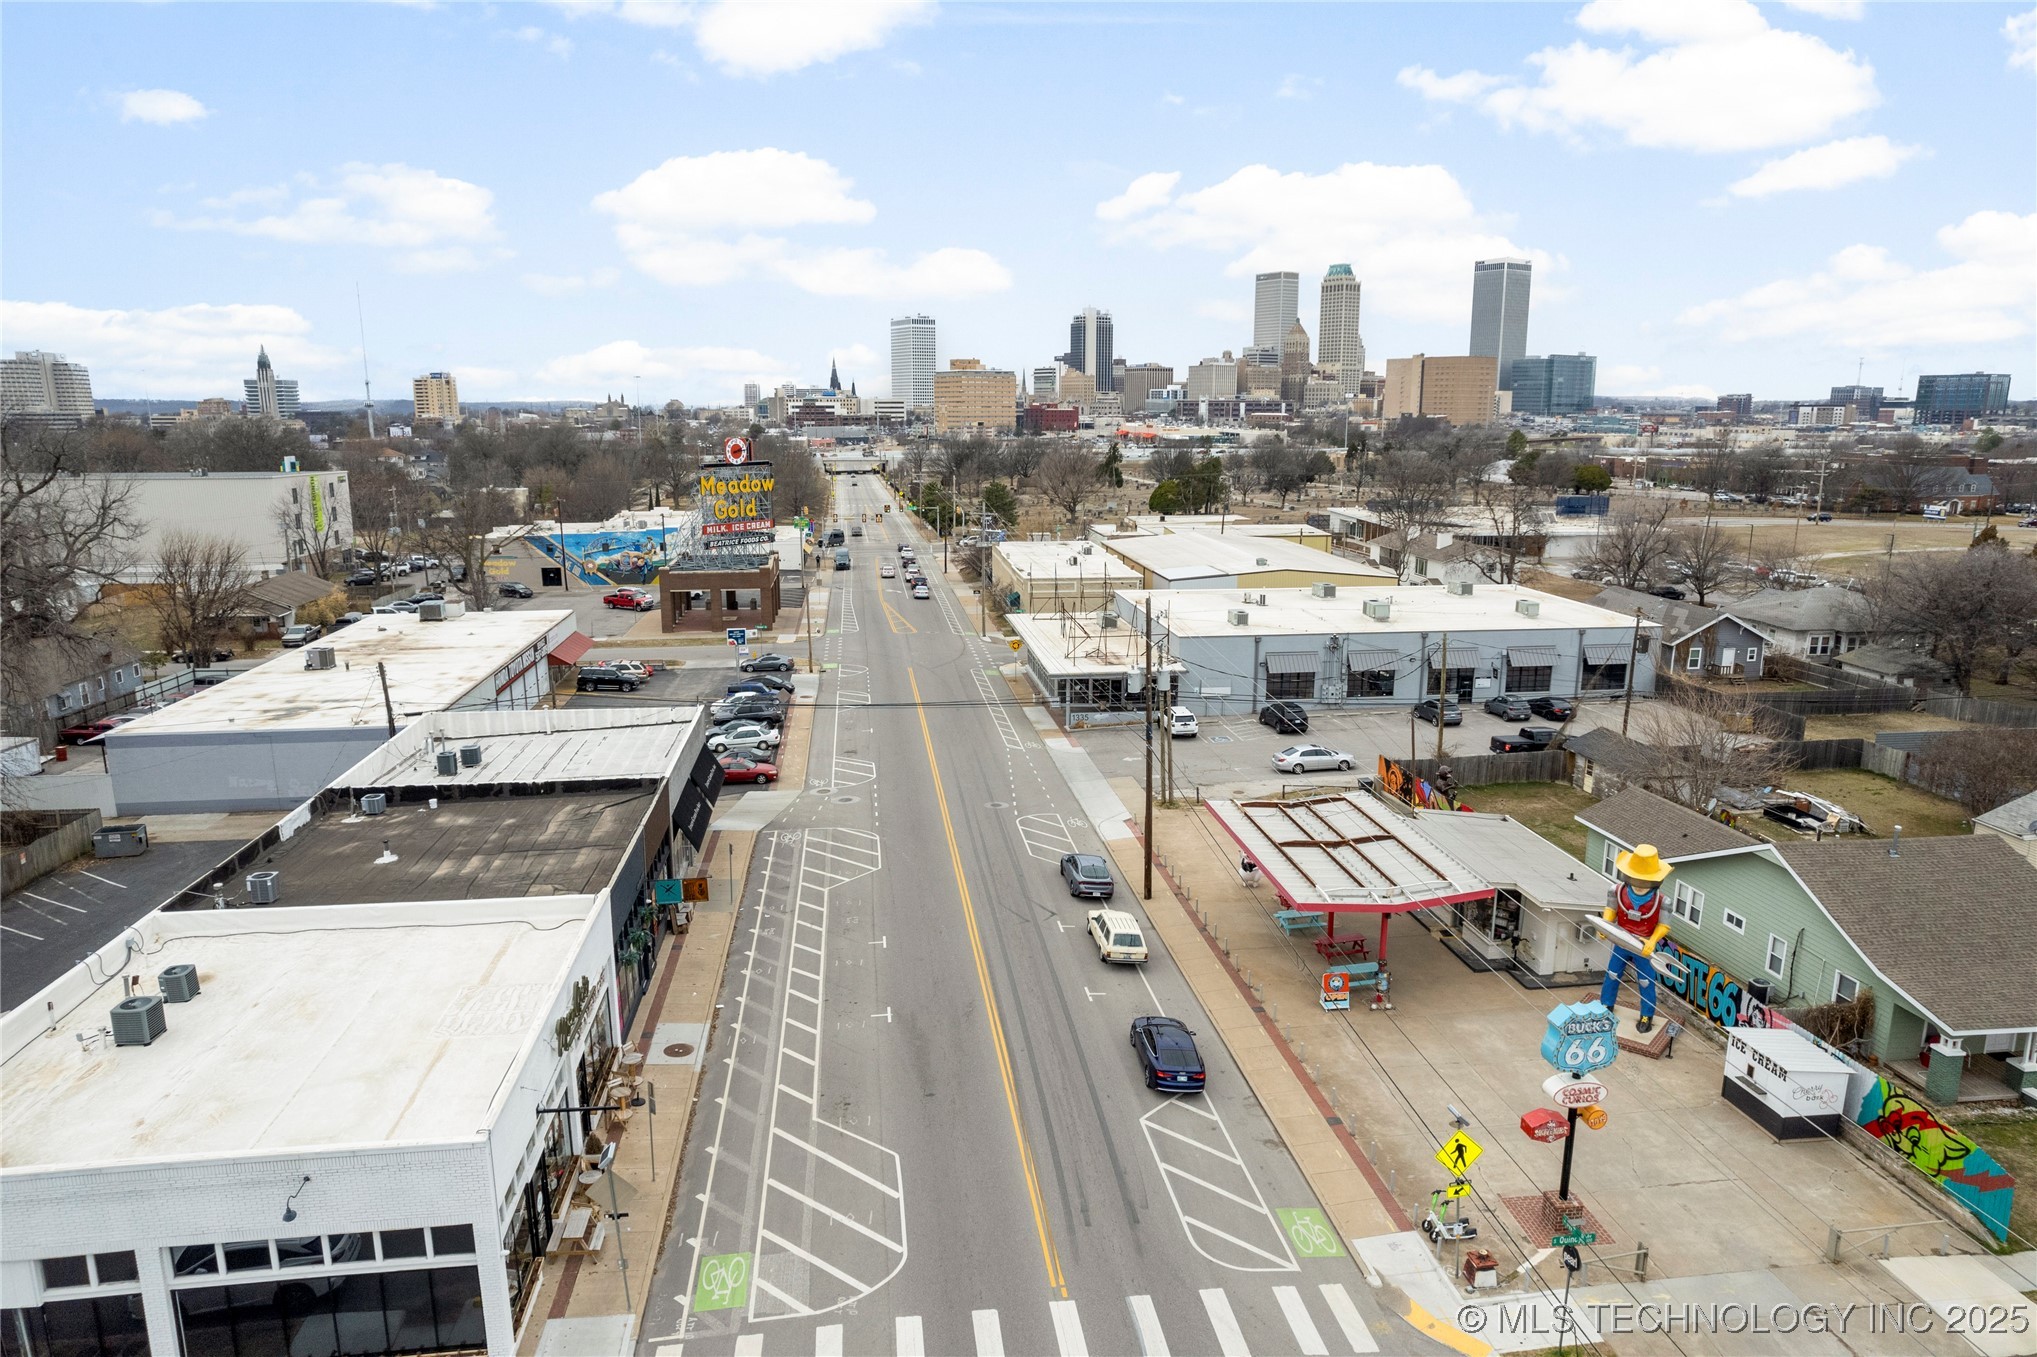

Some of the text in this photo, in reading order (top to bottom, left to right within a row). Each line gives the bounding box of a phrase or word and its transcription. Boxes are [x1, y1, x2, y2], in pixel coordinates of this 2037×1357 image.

[700, 474, 774, 496] Meadow
[714, 498, 757, 519] Gold
[732, 523, 745, 531] ICE
[746, 520, 771, 530] CREAM
[709, 539, 739, 547] BEATRICE
[1708, 972, 1739, 1027] 66
[1567, 1020, 1611, 1034] BUCK'S
[1565, 1036, 1606, 1066] 66
[1731, 1036, 1788, 1082] ICE CREAM
[1561, 1095, 1600, 1105] CURIOS
[1562, 1086, 1601, 1097] COSMIC
